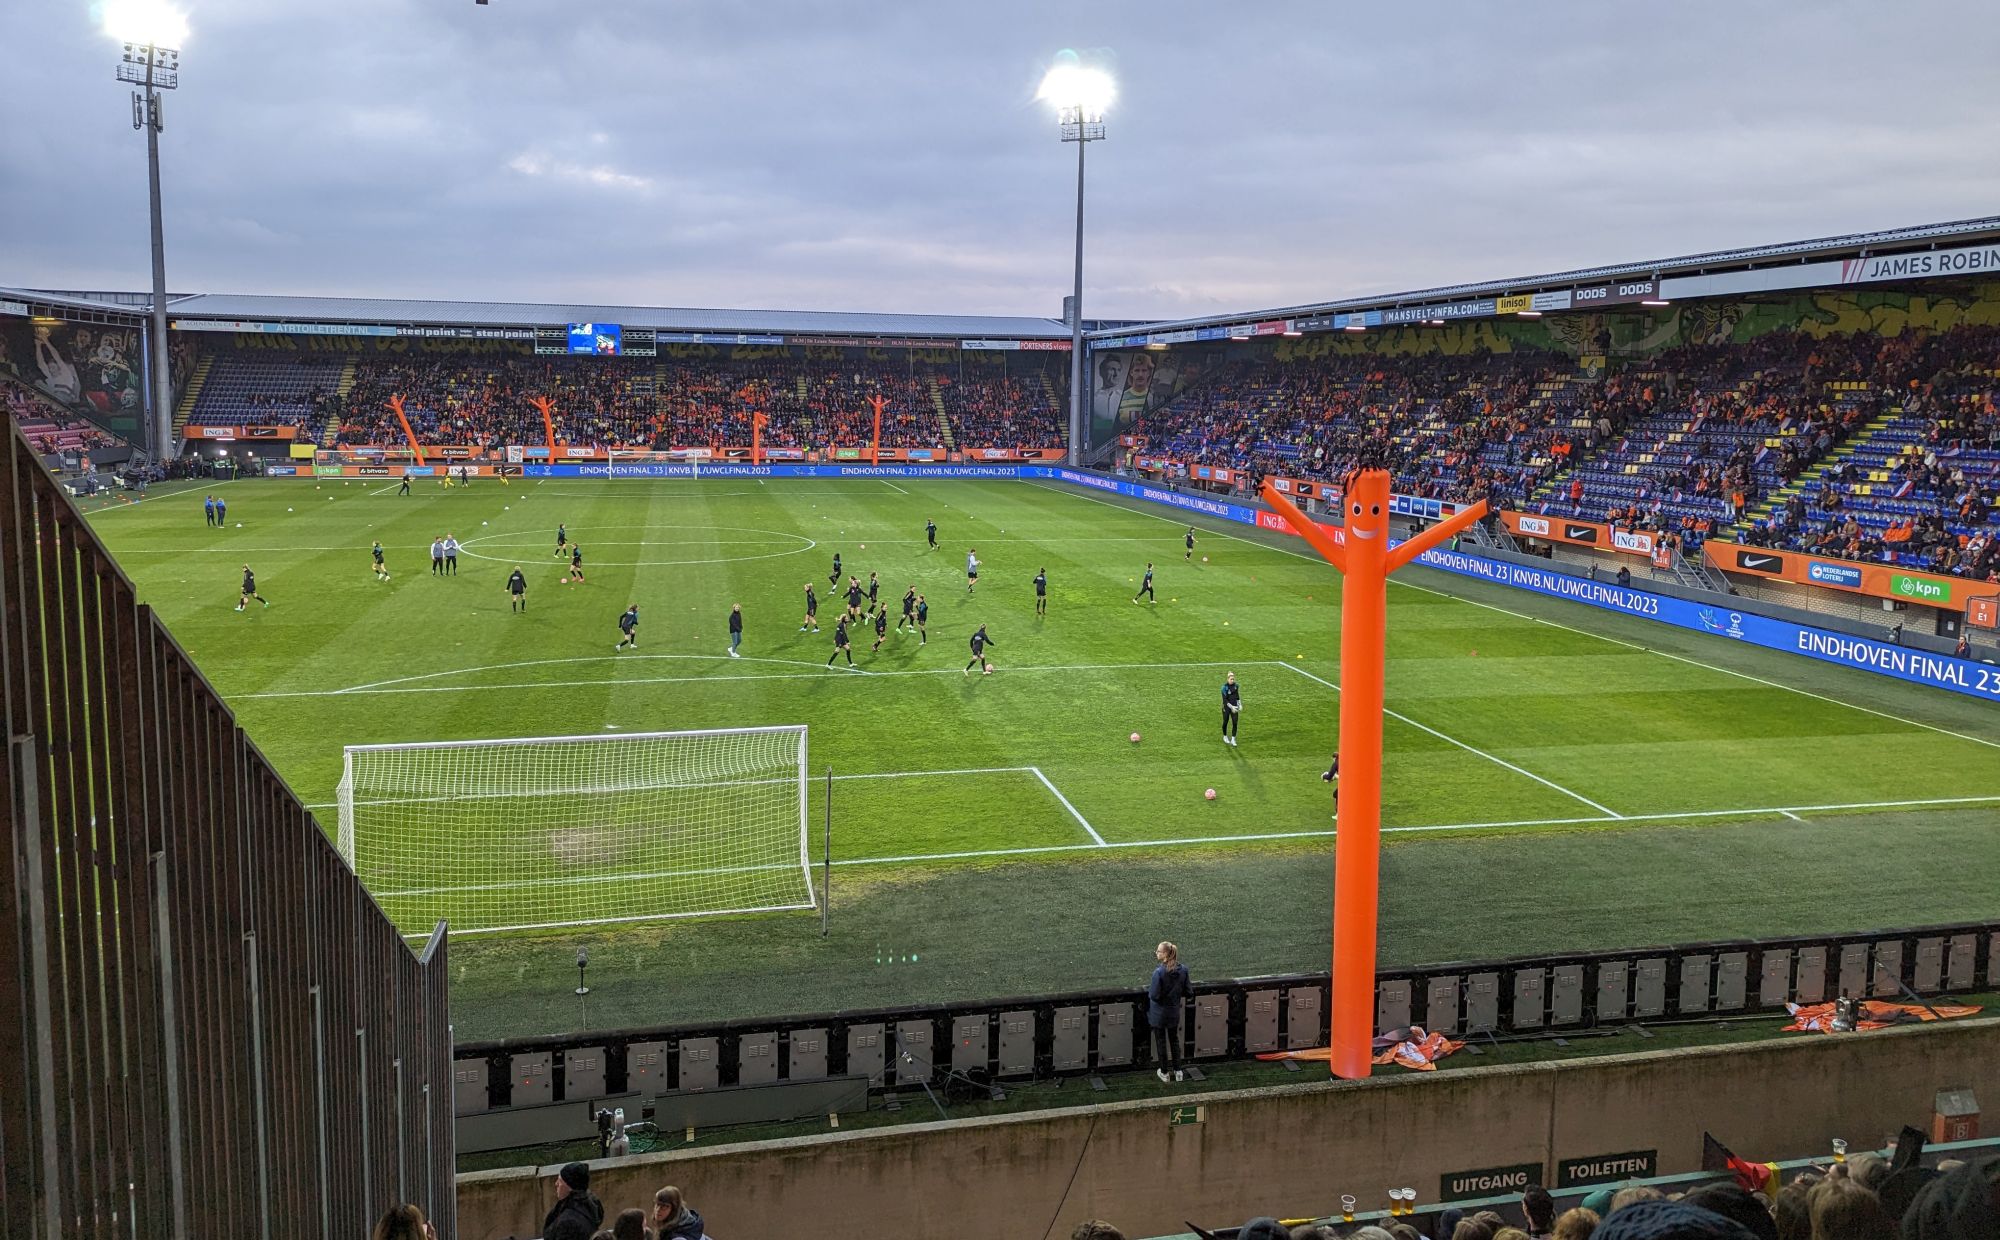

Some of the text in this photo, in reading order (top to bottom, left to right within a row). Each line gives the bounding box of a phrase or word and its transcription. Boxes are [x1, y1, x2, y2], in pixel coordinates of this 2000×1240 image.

[1870, 256, 1932, 278] JAMES
[1576, 287, 1607, 301] DODS
[1619, 282, 1653, 297] DODS
[1501, 296, 1526, 309] linisol
[1387, 303, 1479, 322] MANSVELT-INFRA.COM
[1020, 342, 1053, 351] PORTENERS
[1053, 343, 1072, 351] vloere
[204, 428, 222, 437] ING
[579, 466, 627, 475] EINDHOVEN
[629, 466, 650, 475] FINAL
[654, 466, 664, 475] 23
[841, 467, 886, 475] EINDHOVEN
[886, 467, 906, 475] FINAL
[908, 467, 918, 475] 23
[1263, 515, 1276, 529] ING
[1521, 520, 1536, 532] ING
[1334, 530, 1345, 544] IN
[1616, 534, 1636, 549] ING
[1822, 566, 1859, 579] NEDERLANDSE
[1822, 573, 1844, 583] LOTERIJ
[1421, 550, 1658, 615] EINDHOVEN FINAL 23 KNVB.NL/UWCLFINAL2023
[1916, 582, 1941, 597] kpn
[1978, 612, 1988, 622] E1
[1799, 631, 2000, 695] EINDHOVEN FINAL 23
[1568, 1157, 1648, 1179] TOILETTEN
[1453, 1171, 1528, 1193] UITGANG
